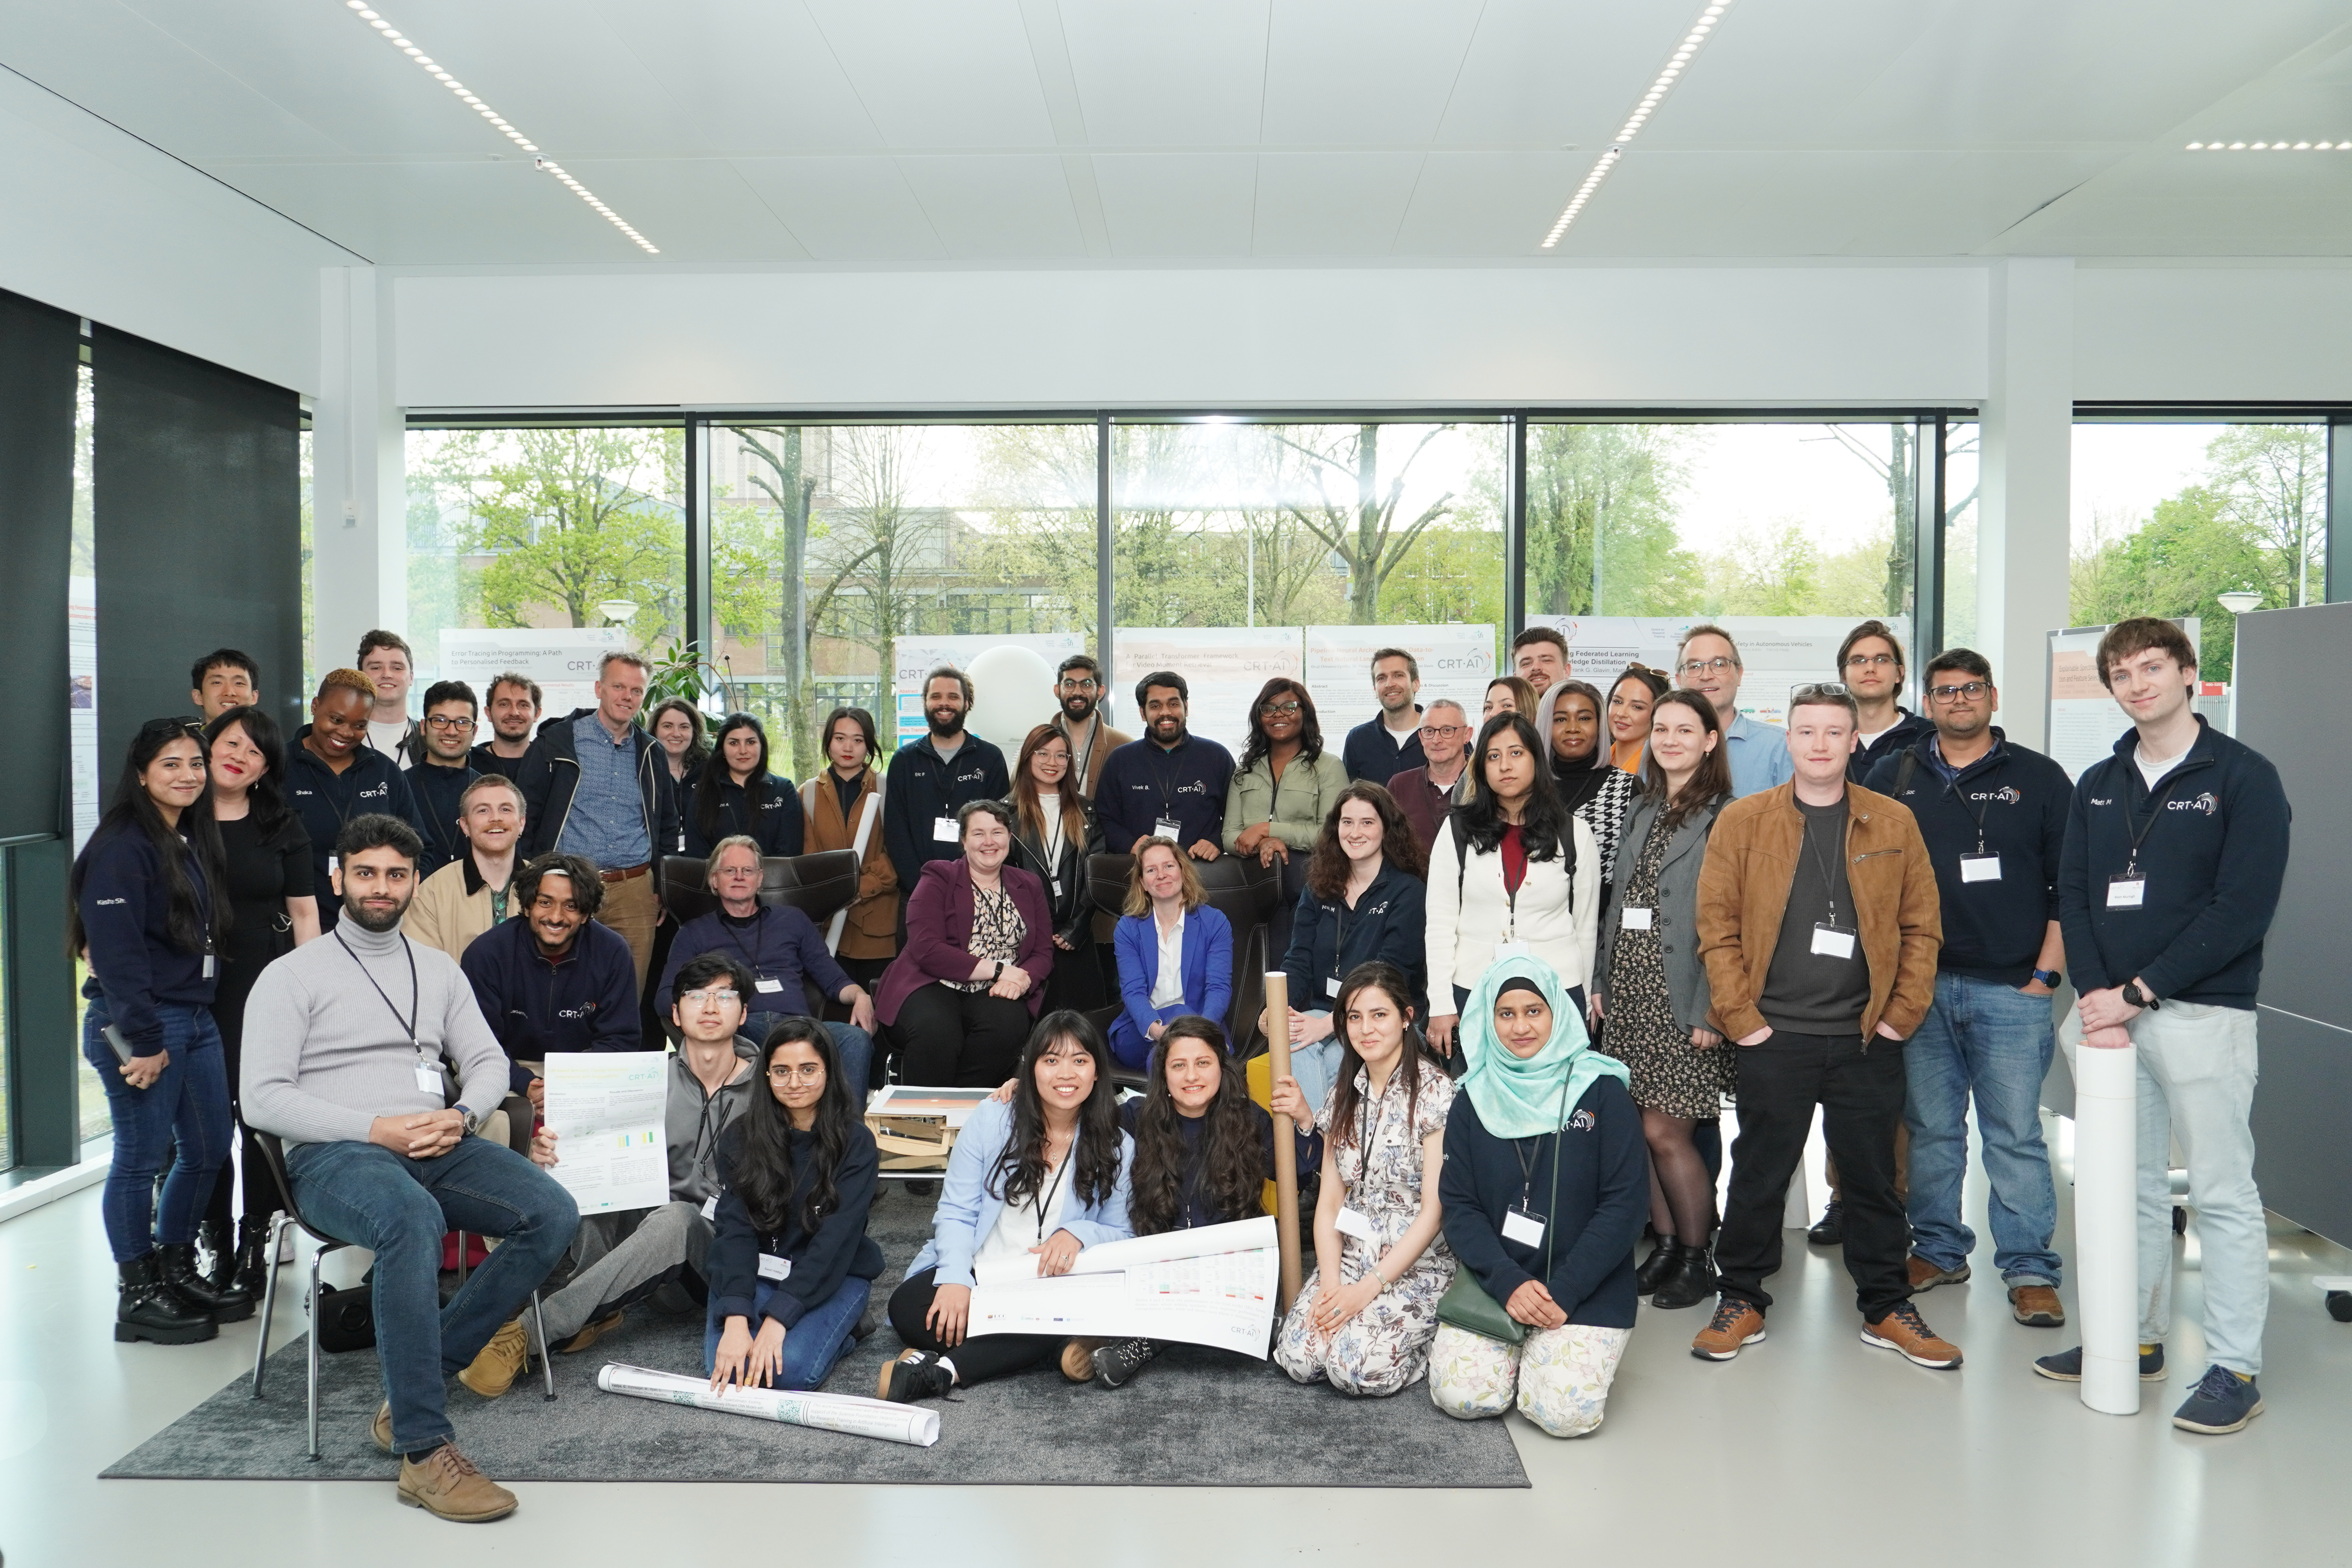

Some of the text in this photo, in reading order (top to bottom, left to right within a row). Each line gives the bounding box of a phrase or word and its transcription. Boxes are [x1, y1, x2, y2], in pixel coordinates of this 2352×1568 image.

[2059, 664, 2079, 673] Explainable
[2091, 798, 2105, 806] Matt
[1238, 1308, 1260, 1317] performance
[843, 1423, 870, 1432] 18/CRT/6223.
